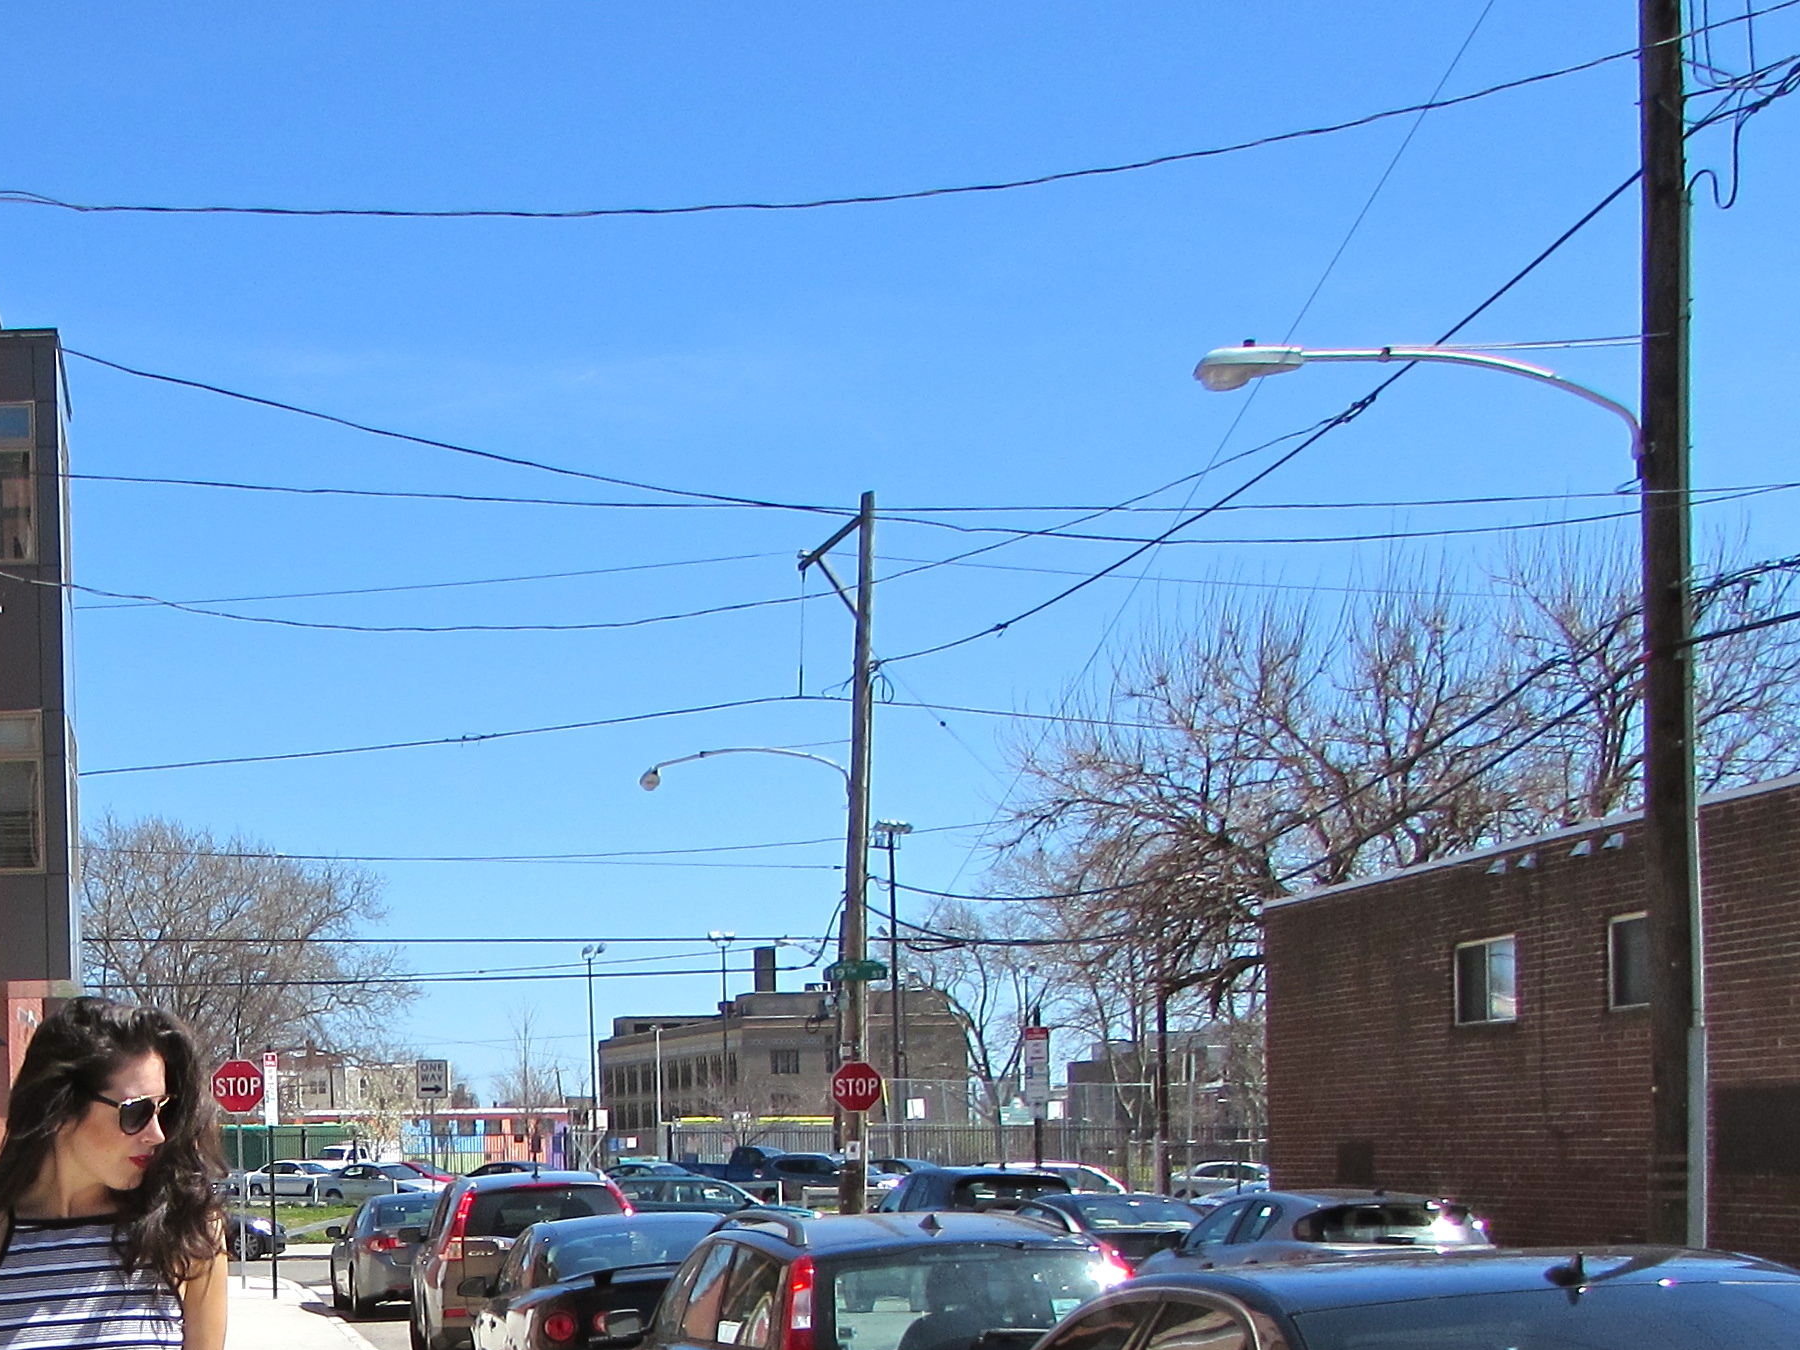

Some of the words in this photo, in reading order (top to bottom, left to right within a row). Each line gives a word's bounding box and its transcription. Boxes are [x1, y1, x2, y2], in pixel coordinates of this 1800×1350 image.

[420, 1063, 443, 1071] ONE
[421, 1073, 443, 1081] WAY
[215, 1077, 261, 1097] STOP
[835, 1078, 878, 1097] STOP
